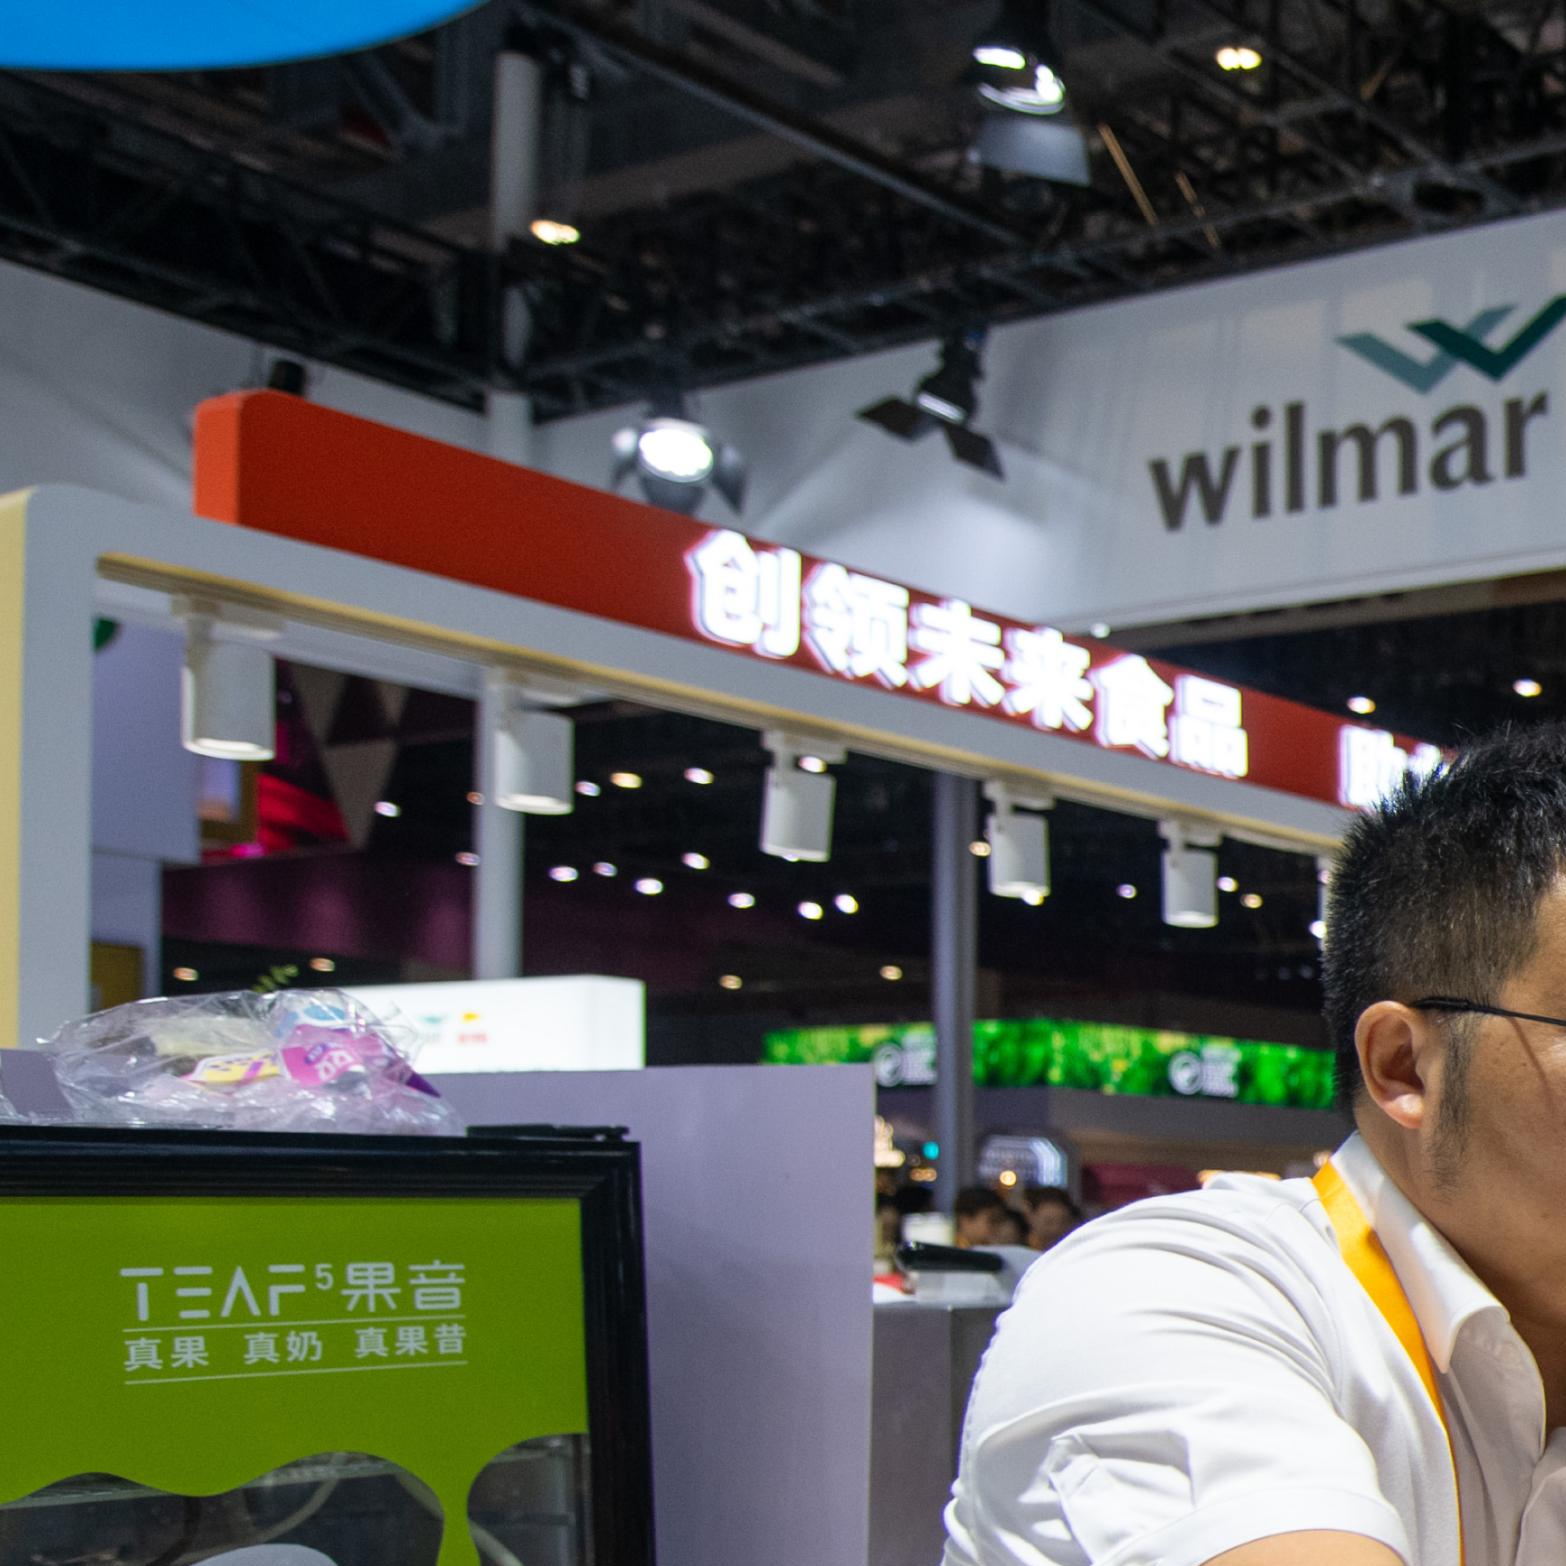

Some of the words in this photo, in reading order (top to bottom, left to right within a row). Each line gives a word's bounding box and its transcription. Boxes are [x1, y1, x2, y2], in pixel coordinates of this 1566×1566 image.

[1149, 391, 1550, 533] wilmar
[685, 528, 1250, 780] 创领未来食品
[340, 1259, 466, 1314] 果音
[124, 1336, 209, 1372] 真果
[243, 1330, 323, 1365] 真奶
[354, 1323, 467, 1359] 真果昔
